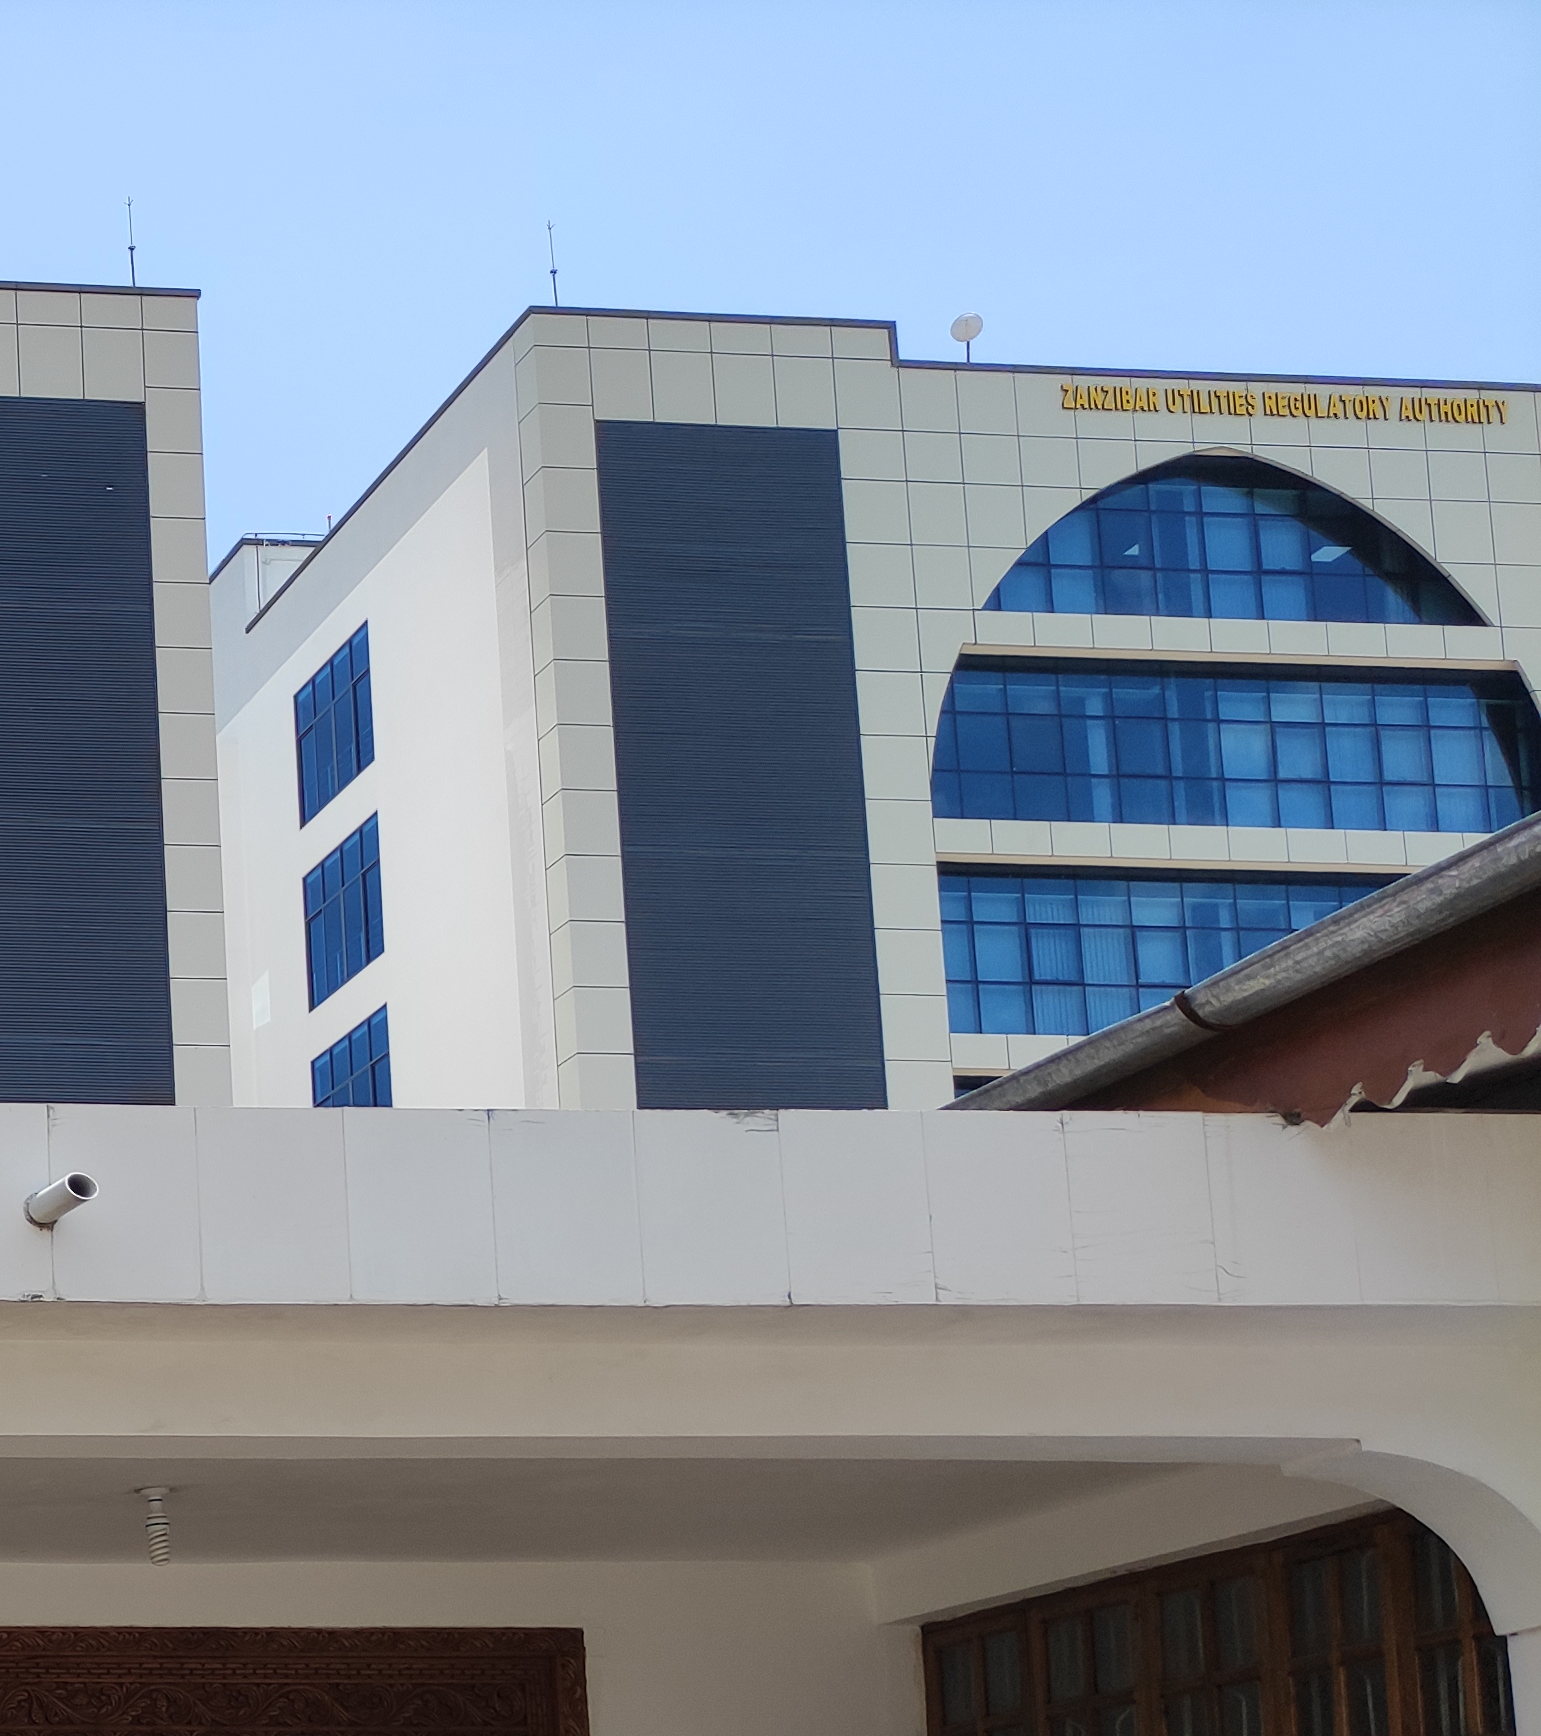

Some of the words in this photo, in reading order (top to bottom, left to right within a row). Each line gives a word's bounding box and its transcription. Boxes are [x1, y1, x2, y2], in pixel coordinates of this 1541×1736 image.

[1062, 383, 1161, 412] ZANZIBAR
[1166, 387, 1260, 418] UTILITIES
[1264, 391, 1392, 420] REGULATORY
[1401, 397, 1509, 424] AUTHORITY
